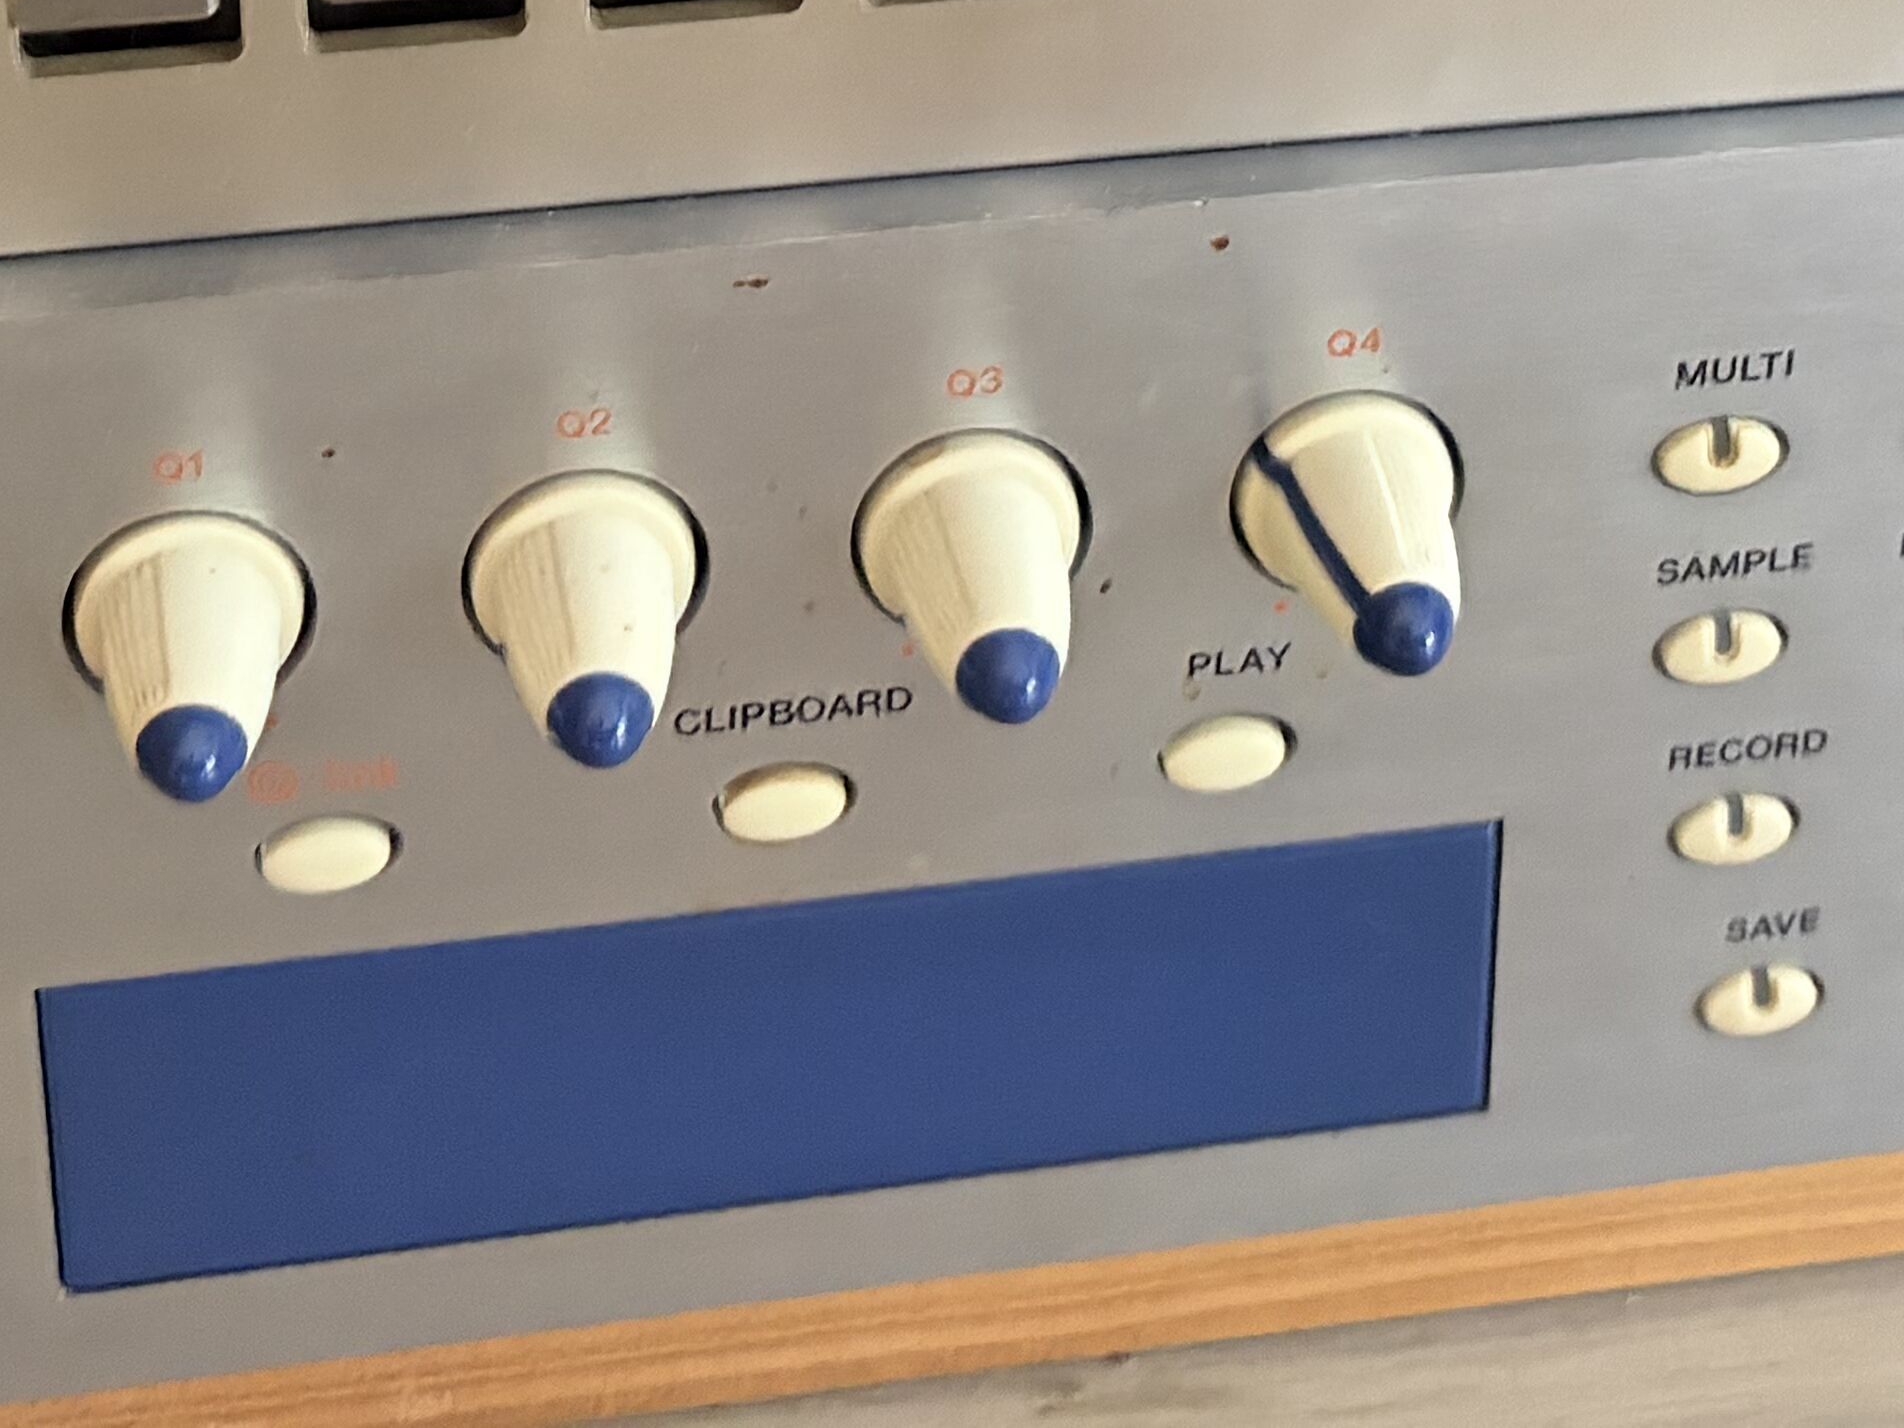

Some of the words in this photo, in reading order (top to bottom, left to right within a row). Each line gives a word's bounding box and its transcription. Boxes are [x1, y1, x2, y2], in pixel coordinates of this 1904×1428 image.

[1326, 328, 1384, 360] Q4
[946, 366, 1006, 398] Q3
[1674, 350, 1796, 392] MULTI
[556, 408, 612, 438] Q2
[152, 450, 204, 482] Q1
[1656, 542, 1814, 586] SAMPLE
[1186, 644, 1292, 678] PLAY
[674, 684, 914, 736] CLIPBOARD
[1668, 728, 1828, 770] RECORD
[1726, 908, 1820, 944] SAVE
